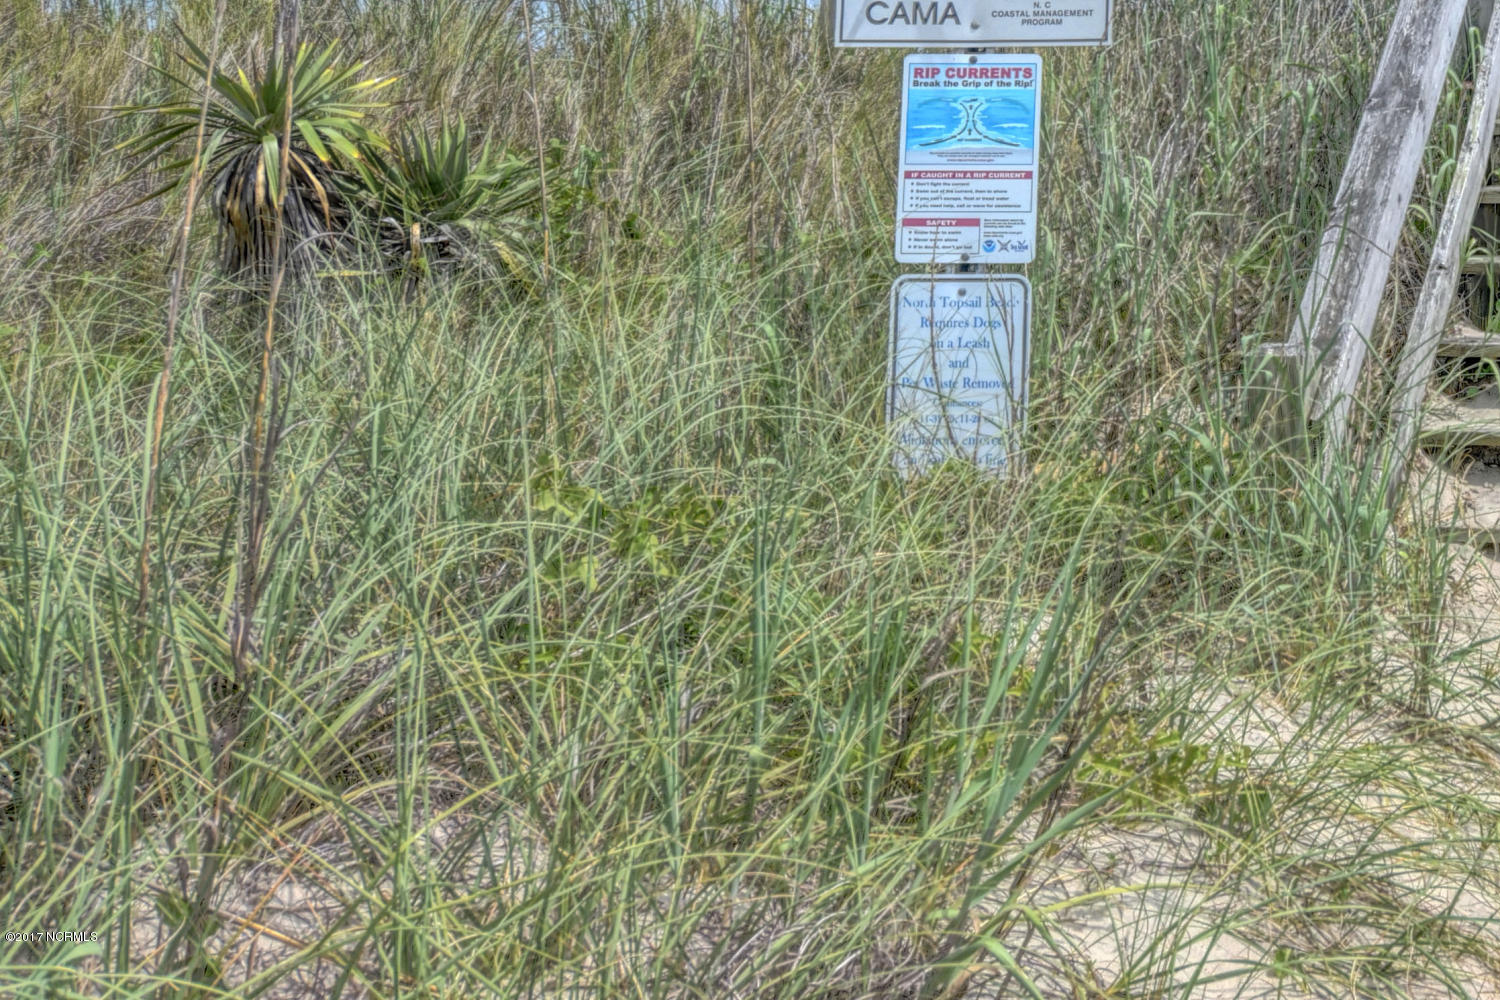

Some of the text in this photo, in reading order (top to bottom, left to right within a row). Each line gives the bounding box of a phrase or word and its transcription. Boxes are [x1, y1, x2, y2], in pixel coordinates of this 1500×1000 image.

[866, 1, 961, 25] CAMA
[914, 67, 1032, 78] RIP CURRENTS
[940, 296, 981, 308] Topsail
[957, 337, 990, 348] Leash
[949, 357, 968, 368] and
